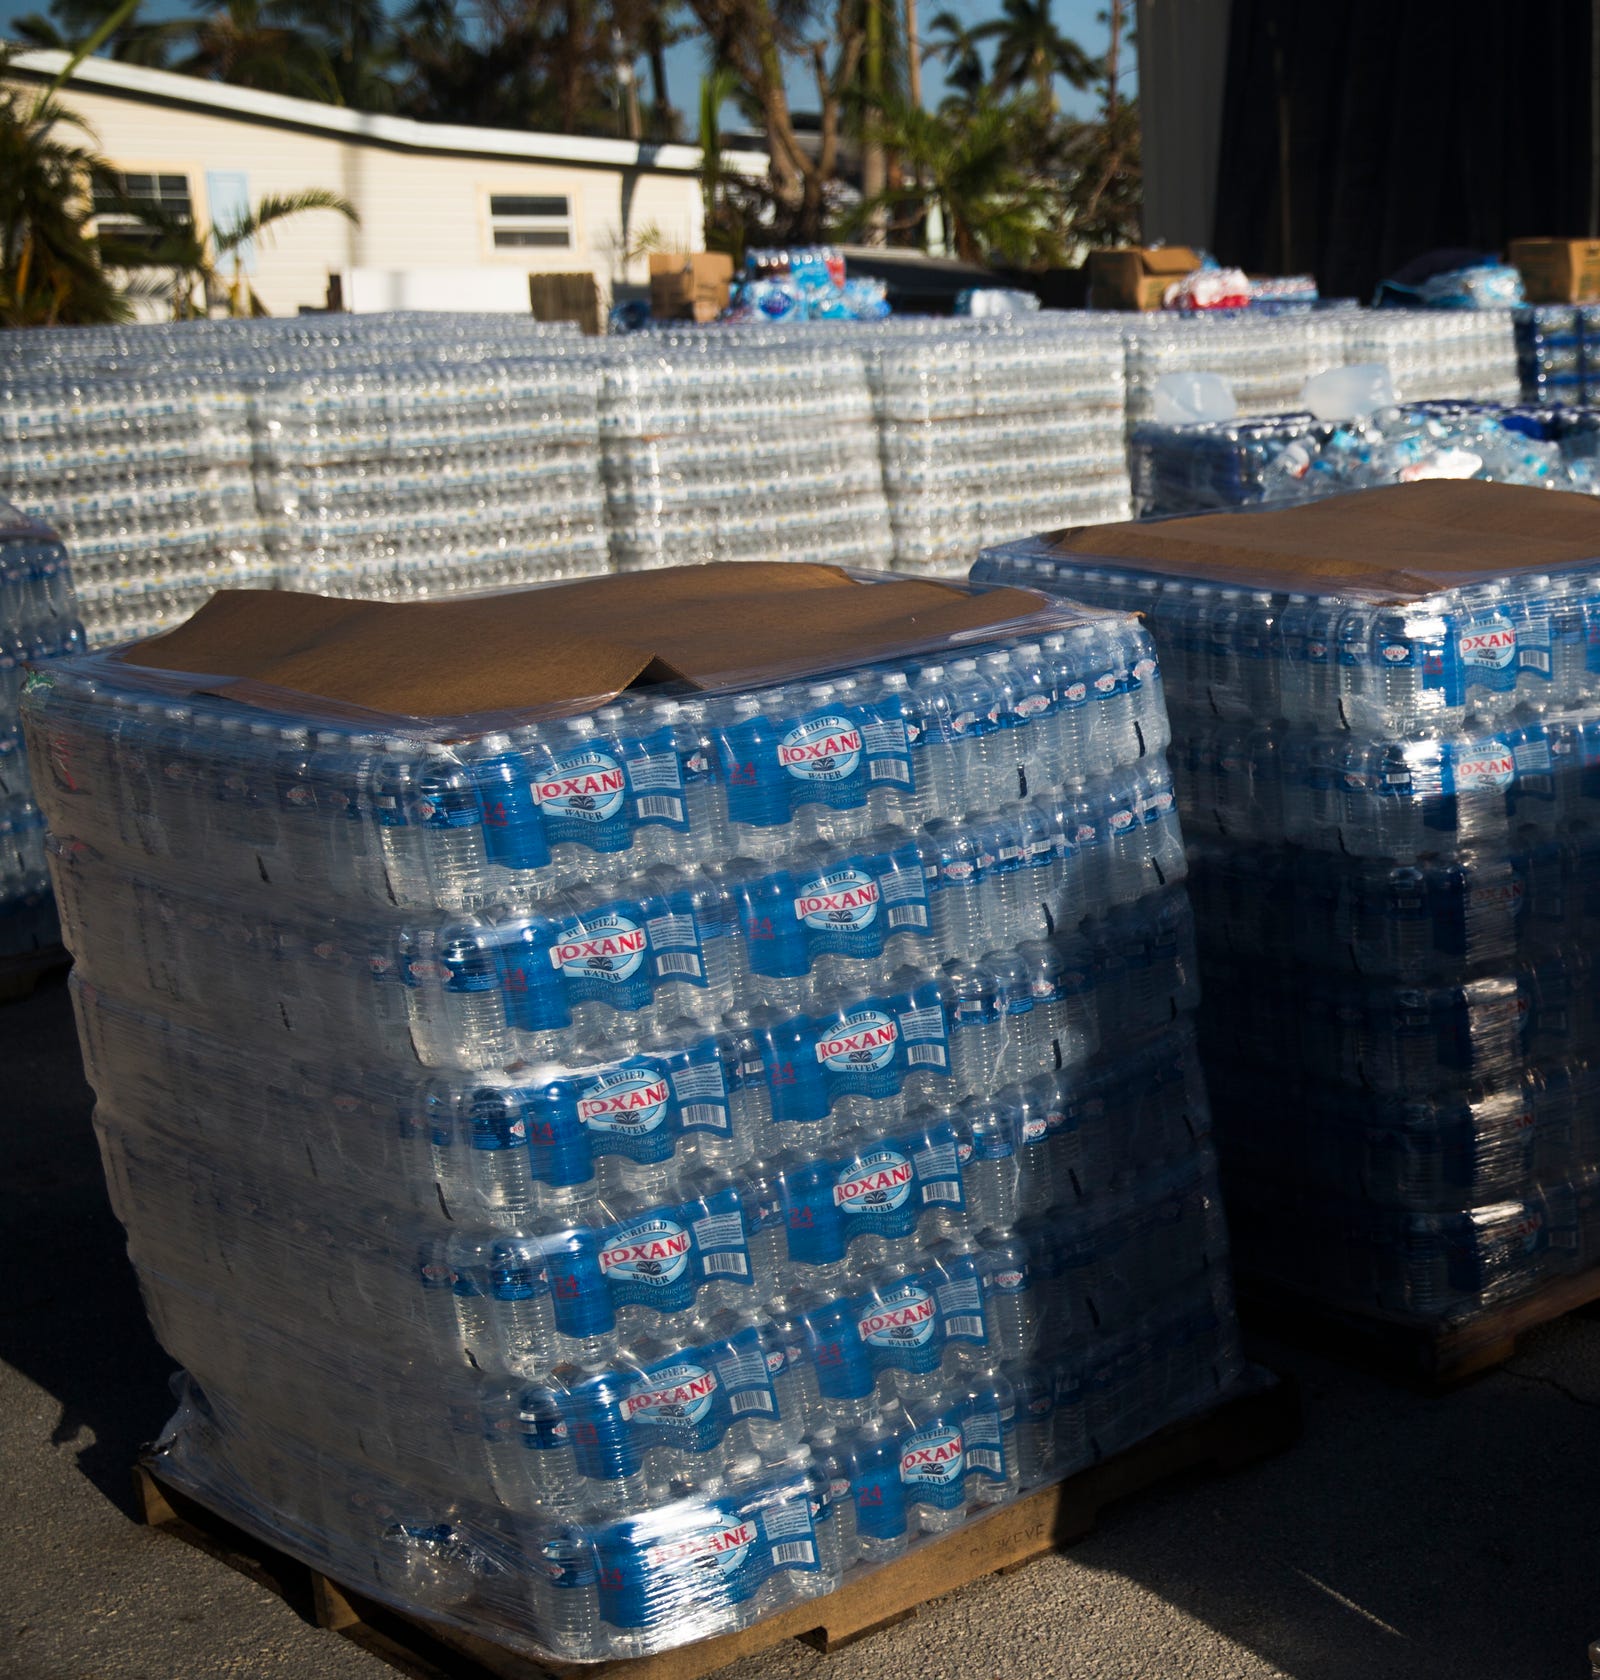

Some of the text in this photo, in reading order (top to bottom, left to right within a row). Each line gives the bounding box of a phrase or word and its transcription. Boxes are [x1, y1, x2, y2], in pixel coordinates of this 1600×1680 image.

[1462, 630, 1516, 651] OXAN
[791, 718, 839, 740] PURIFIED
[783, 731, 861, 764] ROXANE
[728, 762, 755, 778] 24
[1460, 757, 1514, 776] OXAN
[808, 770, 843, 780] WATER
[482, 802, 506, 819] 24
[565, 809, 603, 820] WATER
[799, 883, 879, 916] ROXANE
[746, 917, 772, 932] 24
[825, 921, 859, 931] WATER
[502, 968, 525, 984] 24
[584, 969, 621, 981] WATER
[820, 1023, 895, 1059] ROXANE
[769, 1061, 795, 1079] 24
[846, 1062, 879, 1072] WATER
[593, 1069, 645, 1094] PURIFIED
[582, 1080, 668, 1117] ROXANE
[529, 1121, 554, 1138] 24
[610, 1123, 648, 1134] WATER
[837, 1163, 912, 1201] ROXANE
[788, 1208, 813, 1223] 24
[861, 1203, 894, 1213] WATER
[616, 1220, 667, 1243] PURIFIED
[603, 1233, 687, 1267] ROXANE
[555, 1274, 579, 1290] 24
[632, 1273, 670, 1285] WATER
[887, 1338, 921, 1347] WATER
[817, 1344, 842, 1360] 24
[627, 1373, 714, 1414] ROXANE
[655, 1415, 692, 1425] WATER
[904, 1427, 951, 1448] PURIFIED
[902, 1439, 962, 1468] OXAN
[918, 1474, 951, 1483] WATER
[857, 1485, 882, 1500] 24
[599, 1567, 623, 1583] 24
